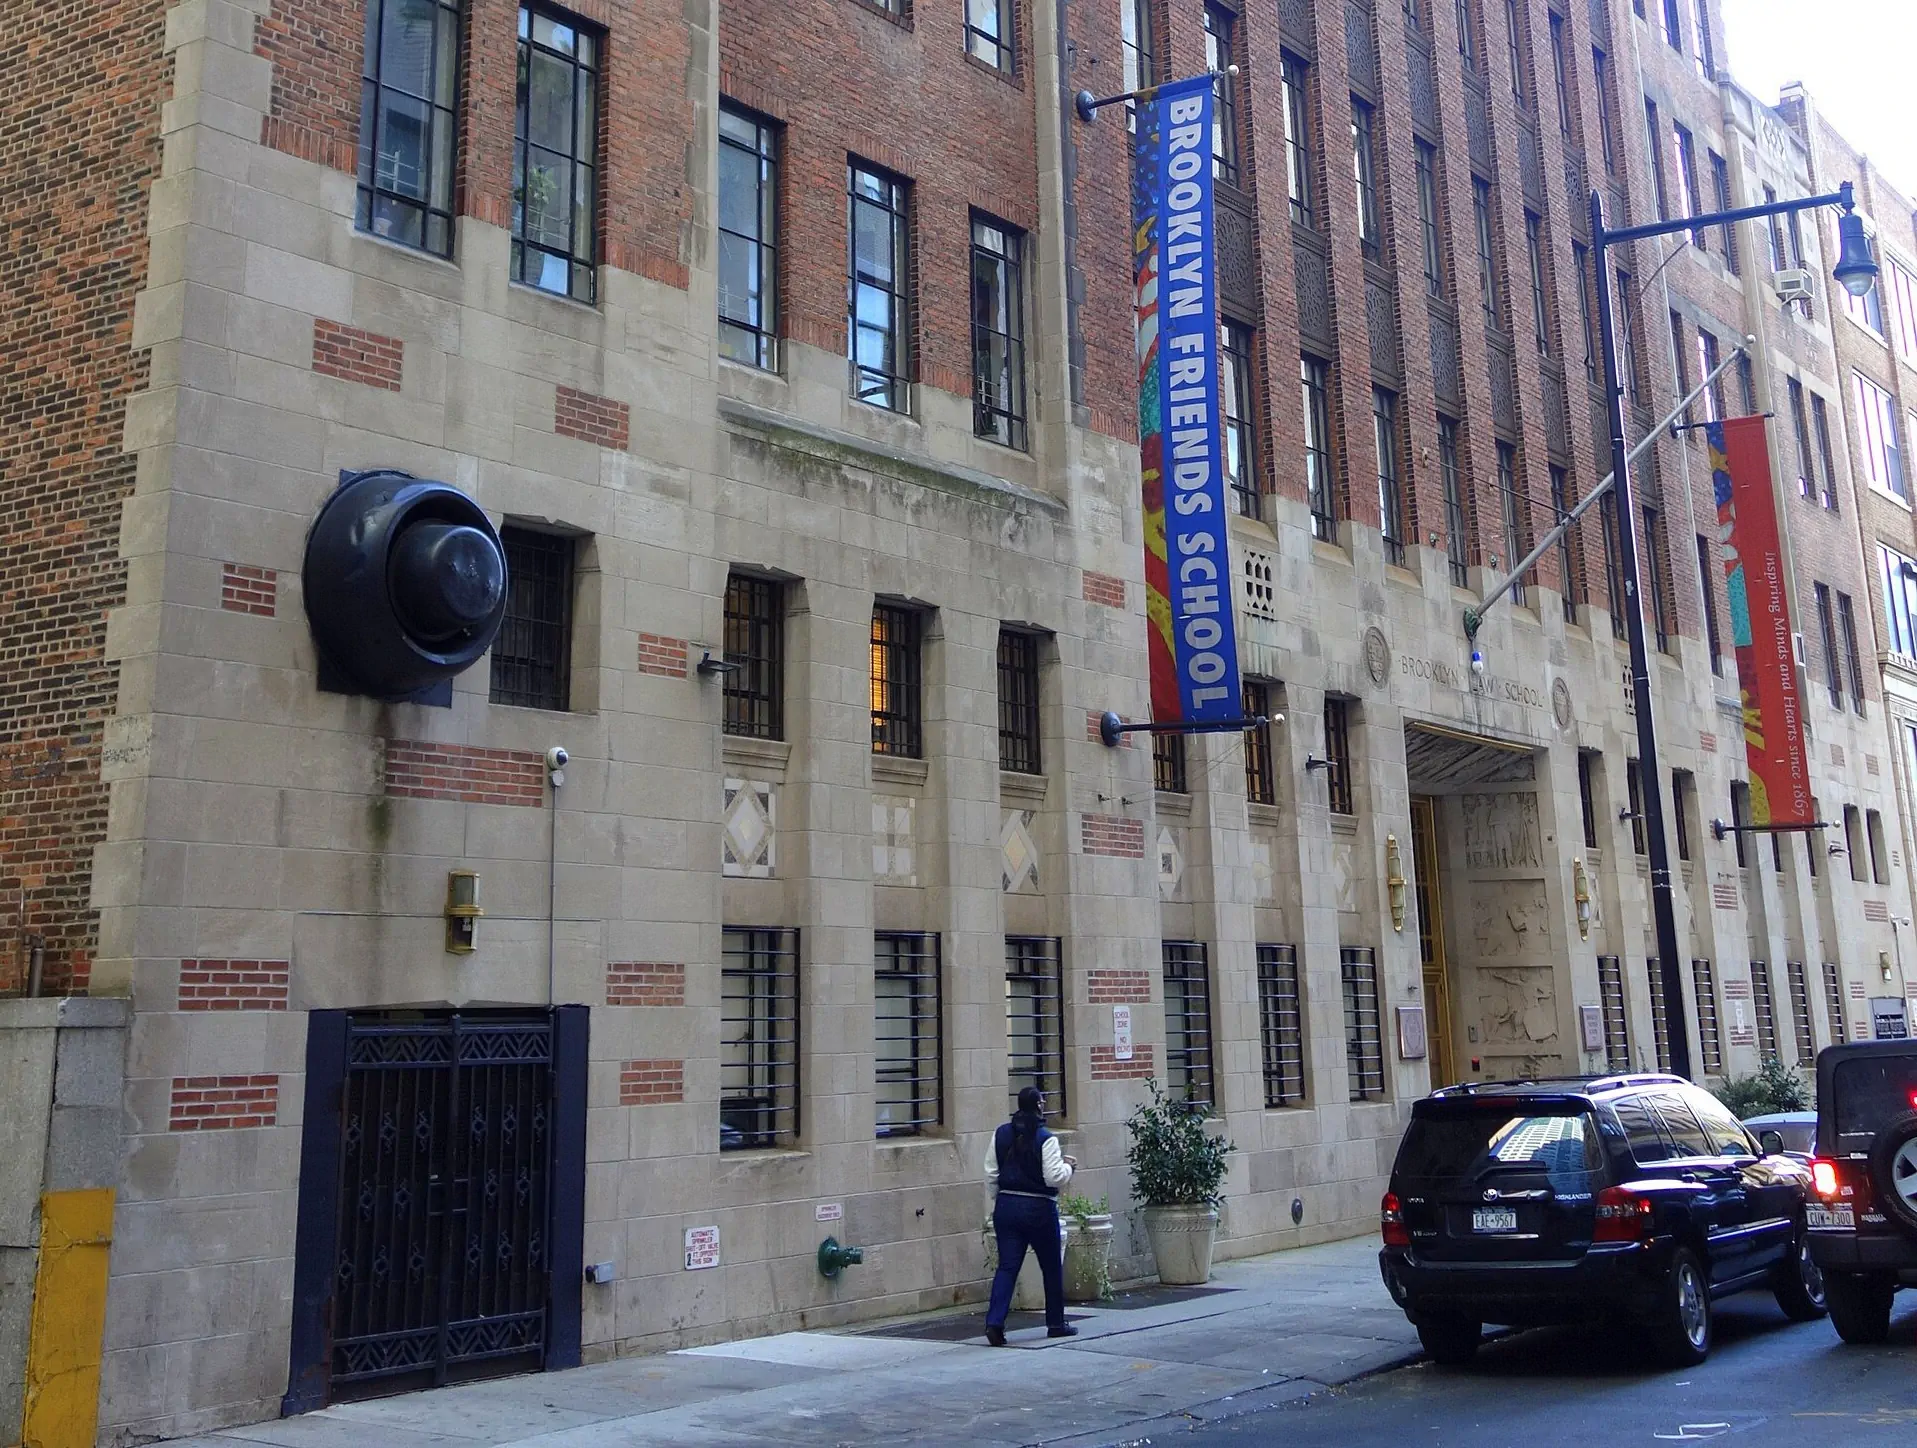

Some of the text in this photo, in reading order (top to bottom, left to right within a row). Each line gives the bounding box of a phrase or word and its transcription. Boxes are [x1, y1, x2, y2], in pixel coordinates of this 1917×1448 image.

[1167, 95, 1229, 709] BROOKLYN FRIENDS SCHOOL
[1401, 655, 1459, 686] BROOKLYN
[1505, 682, 1544, 708] SCHOOL
[1764, 551, 1809, 817] Inspiring Minds and Hearts since 1867
[691, 1230, 714, 1238] AUTOMATIC
[691, 1237, 713, 1245] SPRINKLER
